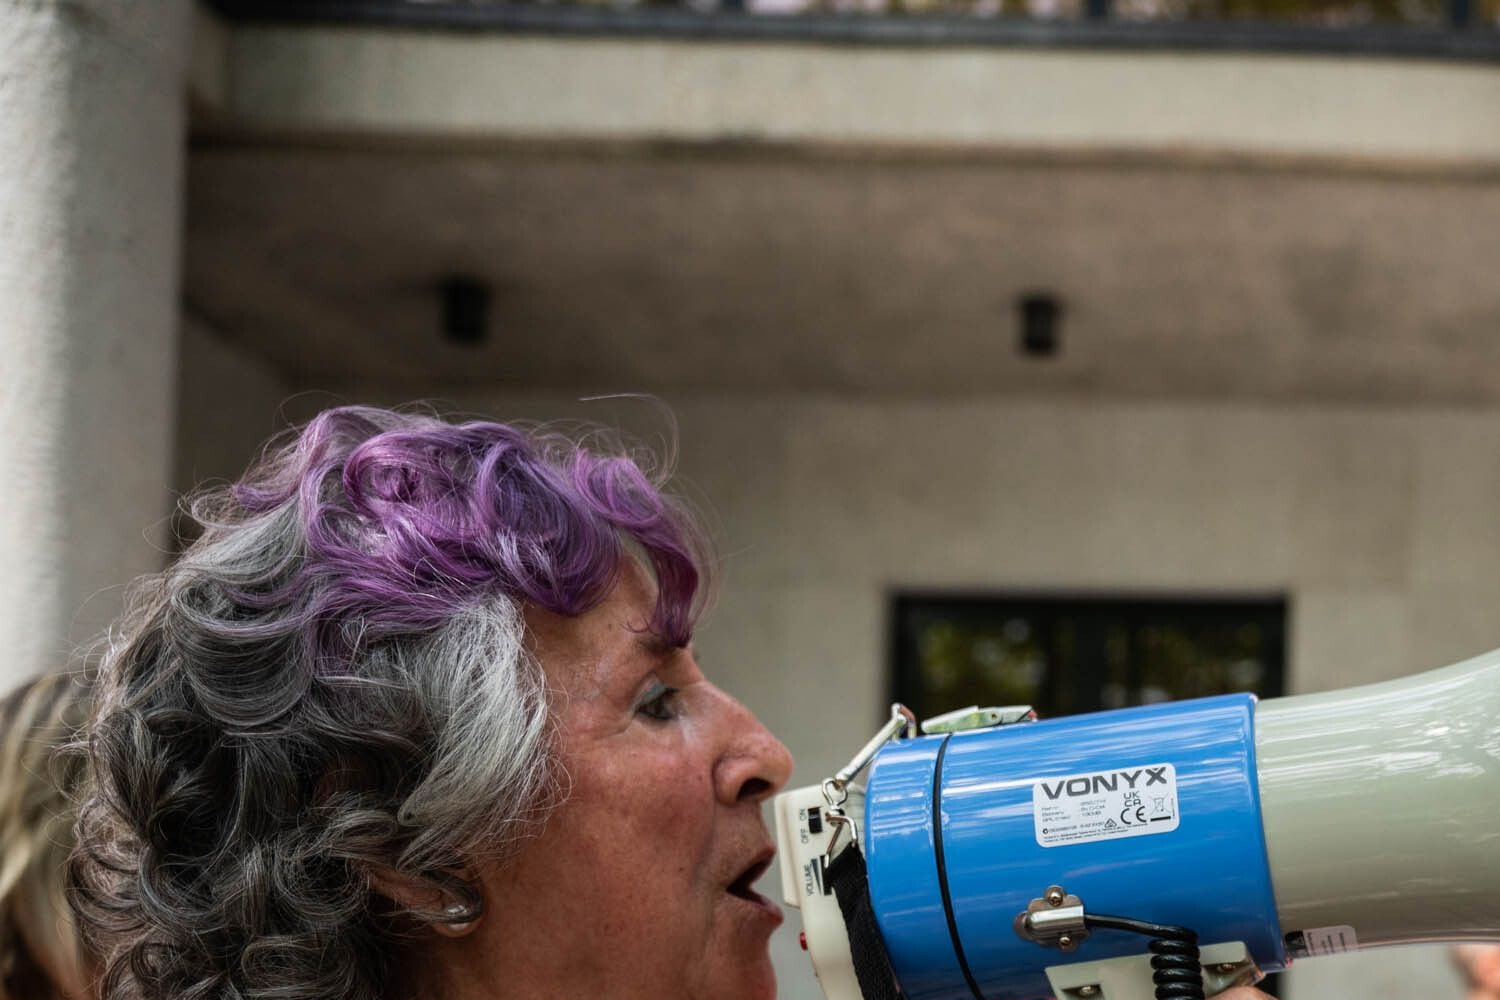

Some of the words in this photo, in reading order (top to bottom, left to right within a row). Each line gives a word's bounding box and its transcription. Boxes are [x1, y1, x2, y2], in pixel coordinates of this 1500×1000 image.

[1041, 766, 1167, 800] VONYX
[1123, 790, 1141, 799] UK
[1124, 799, 1142, 807] CA
[800, 808, 807, 821] ON
[1120, 805, 1147, 825] CE
[801, 828, 809, 844] OFF
[804, 863, 815, 897] VOLUME
